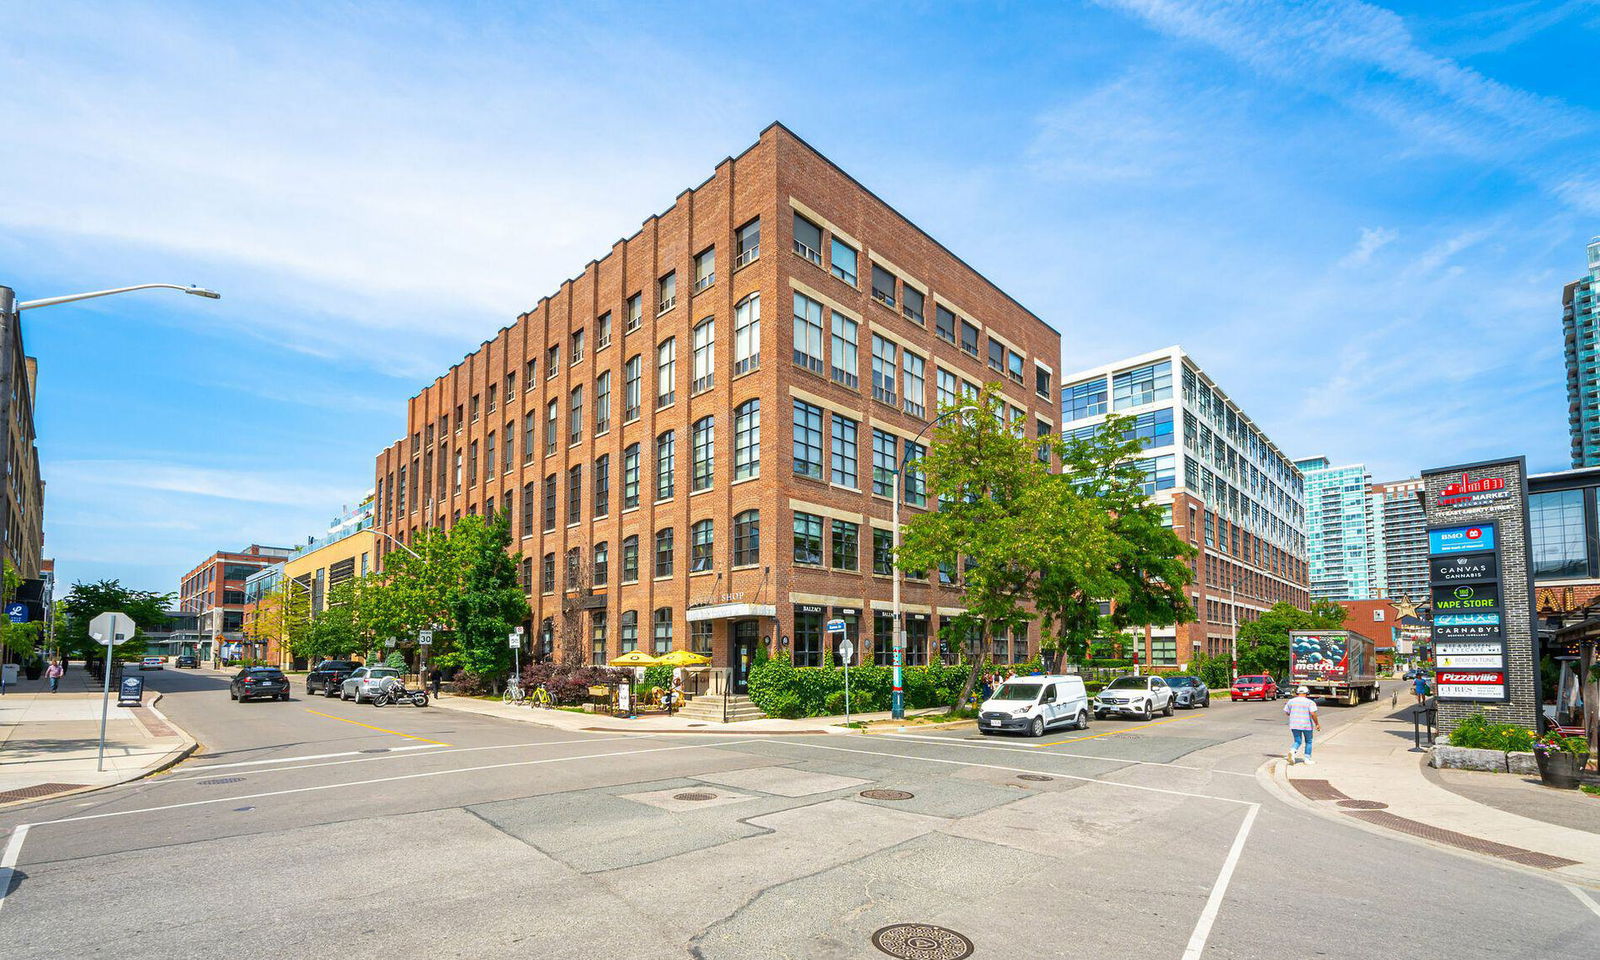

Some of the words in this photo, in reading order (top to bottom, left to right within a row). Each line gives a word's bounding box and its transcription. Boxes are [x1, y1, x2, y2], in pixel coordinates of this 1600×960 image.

[1441, 532, 1463, 540] BMO
[1440, 565, 1486, 574] CANVAS
[721, 592, 744, 601] SHOP
[1437, 601, 1461, 609] VAPE
[1463, 599, 1494, 608] STORE
[420, 635, 431, 643] 30
[1442, 673, 1498, 682] Pizzaville
